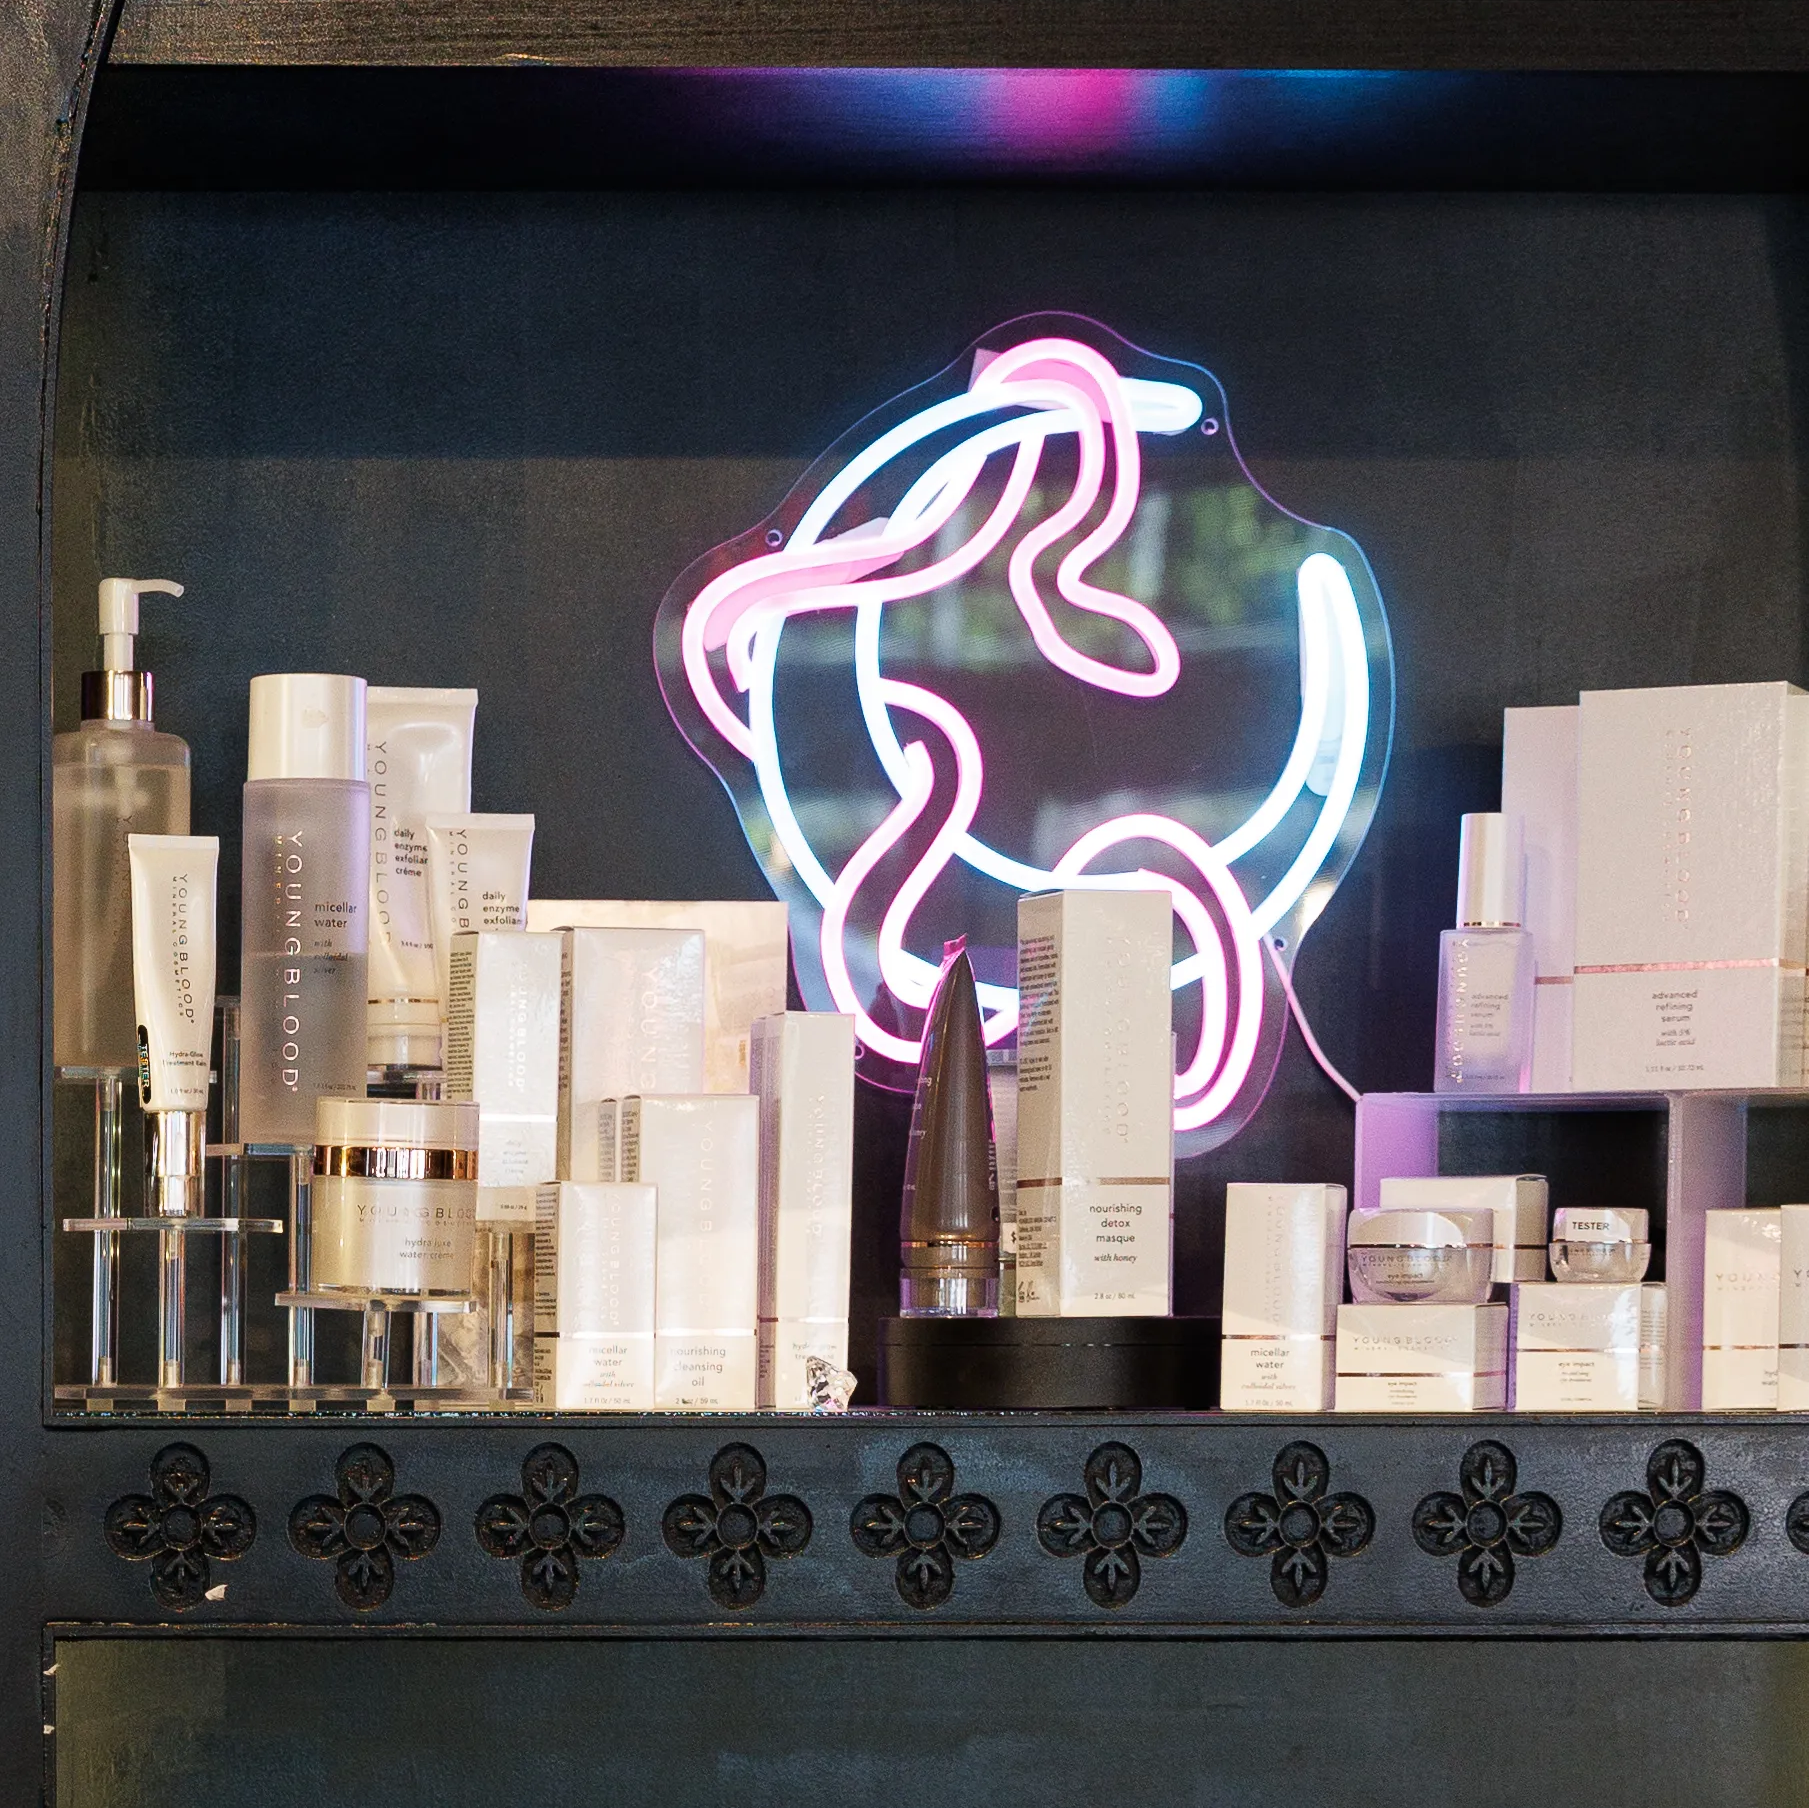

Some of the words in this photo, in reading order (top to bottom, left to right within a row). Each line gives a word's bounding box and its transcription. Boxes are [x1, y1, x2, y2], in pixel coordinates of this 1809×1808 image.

[394, 829, 415, 840] daily
[394, 842, 428, 853] enzyme
[482, 891, 506, 902] daily
[314, 901, 356, 913] micellar
[483, 903, 520, 914] enzyme
[314, 918, 348, 928] water
[178, 873, 194, 1019] YOUNGBLOOD
[282, 831, 303, 1086] YOUNGBLOOD
[1651, 990, 1697, 1000] advanced
[1655, 1002, 1693, 1013] refining
[1661, 1014, 1690, 1023] serum
[1089, 1203, 1143, 1216] nourishing
[1100, 1217, 1130, 1229] detox
[1572, 1221, 1610, 1231] TESTER
[1096, 1233, 1135, 1245] masque
[1094, 1253, 1112, 1263] with
[1113, 1253, 1138, 1265] honey
[670, 1346, 726, 1359] nourishing
[1250, 1347, 1290, 1357] micellar
[594, 1357, 622, 1367] water
[1255, 1360, 1284, 1369] water
[674, 1362, 723, 1374] cleansing
[691, 1377, 705, 1387] oil
